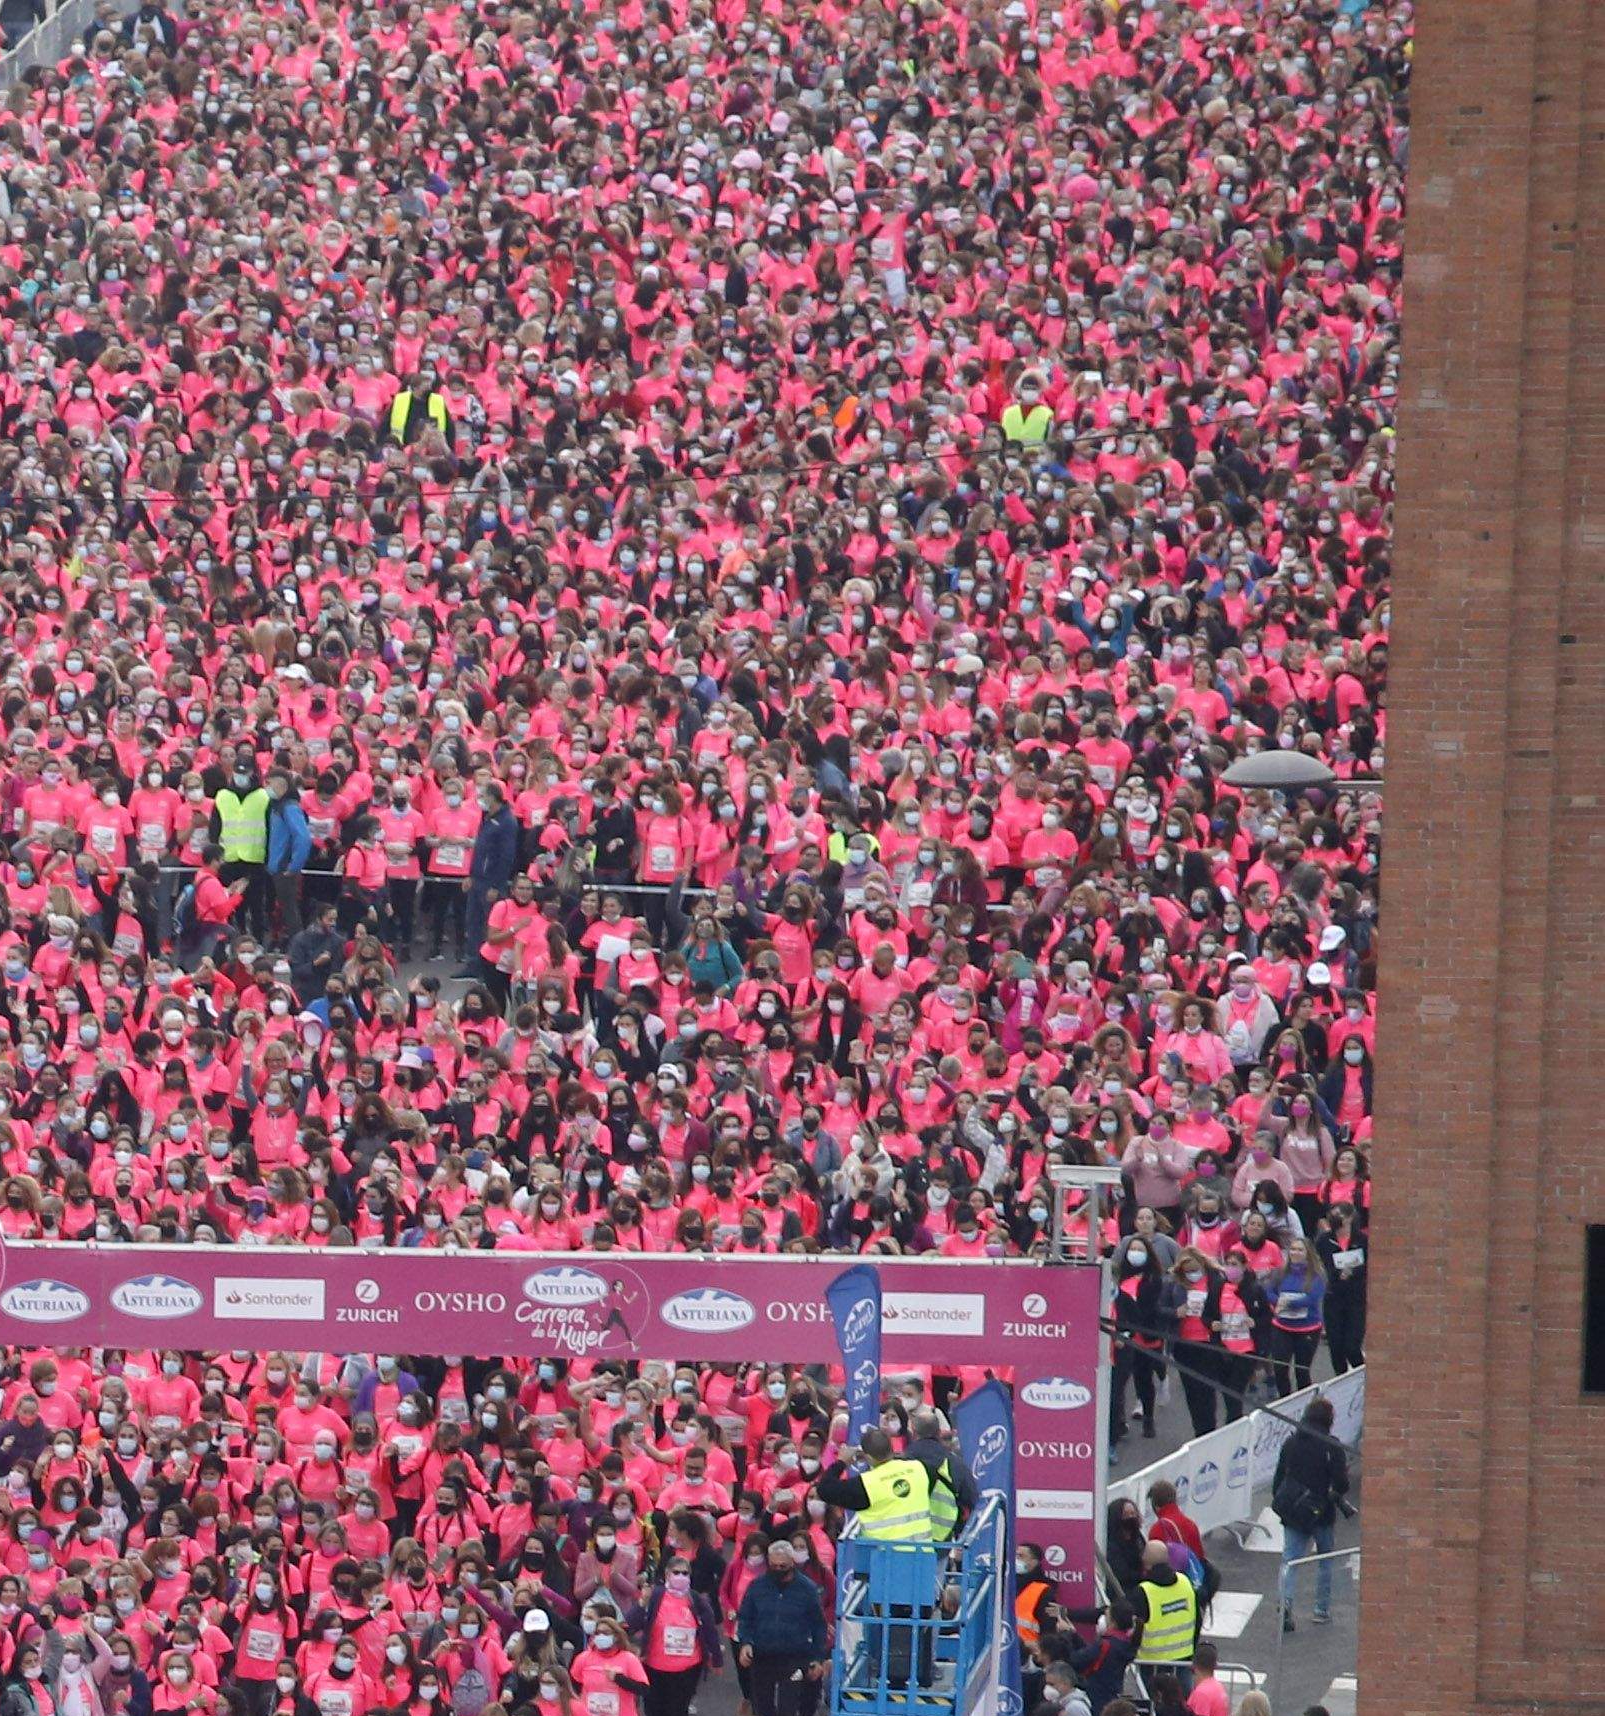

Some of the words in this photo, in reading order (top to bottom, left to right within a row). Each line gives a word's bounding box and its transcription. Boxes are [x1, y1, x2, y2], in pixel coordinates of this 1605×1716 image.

[529, 1280, 604, 1298] ASTURIANA
[6, 1295, 83, 1313] ASTURIANA
[117, 1291, 195, 1309] ASTURIANA
[244, 1291, 313, 1306] Santander
[414, 1292, 507, 1314] OYSHO
[336, 1307, 399, 1323] ZURICH
[514, 1302, 587, 1324] Carrera
[667, 1305, 748, 1323] ASTURIANA
[901, 1307, 973, 1322] Santander
[556, 1321, 611, 1356] Mujer
[1002, 1322, 1068, 1338] ZURICH
[1026, 1389, 1087, 1402] ASTURIANA
[1018, 1441, 1092, 1459] OYSHO
